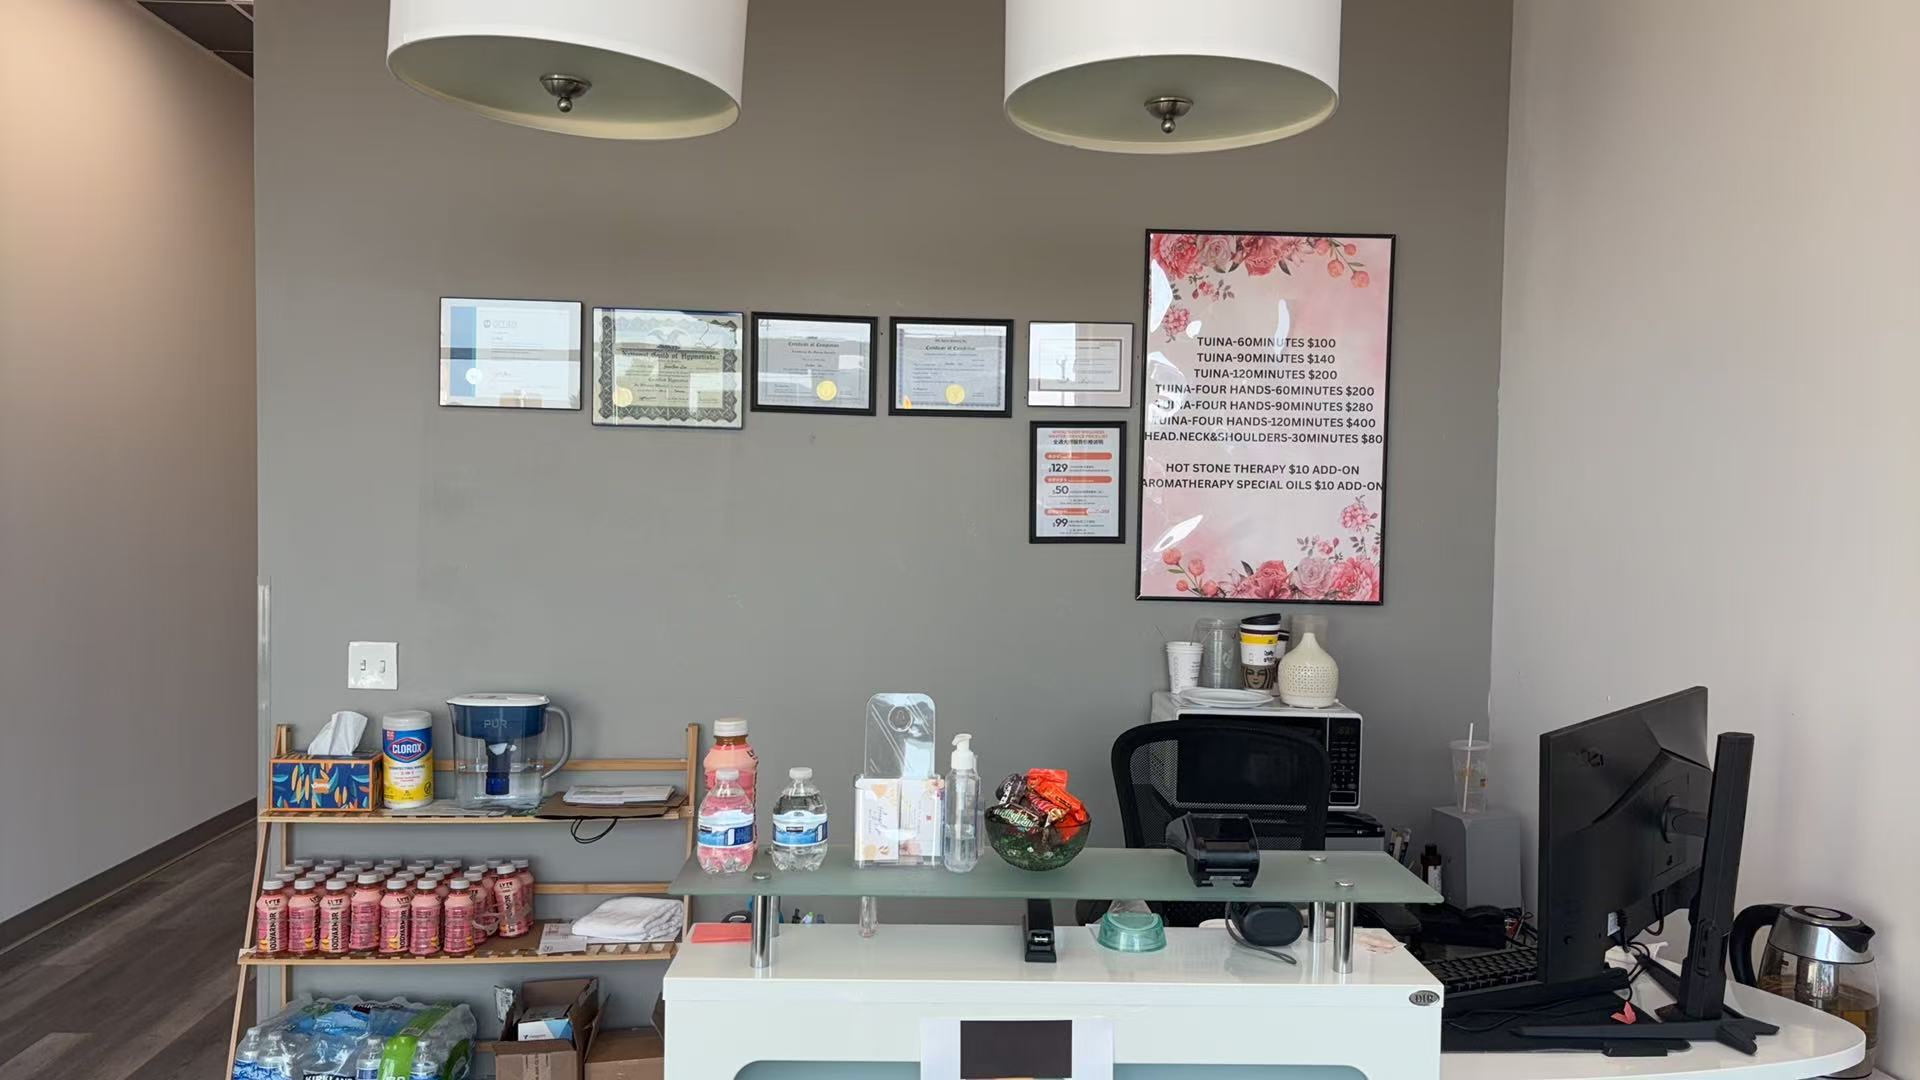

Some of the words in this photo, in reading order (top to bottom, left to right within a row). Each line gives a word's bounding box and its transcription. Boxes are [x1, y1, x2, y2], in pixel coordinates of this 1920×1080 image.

[1197, 336, 1305, 349] TUINA-60MINUTES
[1307, 338, 1336, 349] $100
[1197, 352, 1305, 364] TUINA-90MINUTES
[1307, 354, 1335, 365] $140
[1194, 368, 1305, 380] TUINA-120MINUTES
[1308, 370, 1338, 381] $200
[1229, 385, 1343, 397] HANDS-60MINUTES
[1345, 386, 1375, 398] $200
[1229, 401, 1343, 412] HANDS-90MINUTES
[1345, 402, 1373, 413] $280
[1226, 417, 1344, 428] HANDS-120MINUTES
[1346, 418, 1376, 429] $400
[1144, 431, 1359, 444] HEAD.NECK&SHOULDERS-30MINUTES
[1361, 434, 1383, 445] $80
[1166, 463, 1190, 474] HOT
[1192, 464, 1232, 475] STONE
[1234, 464, 1287, 475] THERAPY
[1289, 465, 1309, 476] $10
[1312, 465, 1360, 476] ADD-ON
[1142, 478, 1234, 490] AROMATHERAPY
[1236, 480, 1284, 491] SPECIAL
[1286, 480, 1312, 491] OILS
[1315, 481, 1335, 492] $10
[1337, 481, 1384, 492] ADD-ON
[392, 743, 422, 754] CLOROX
